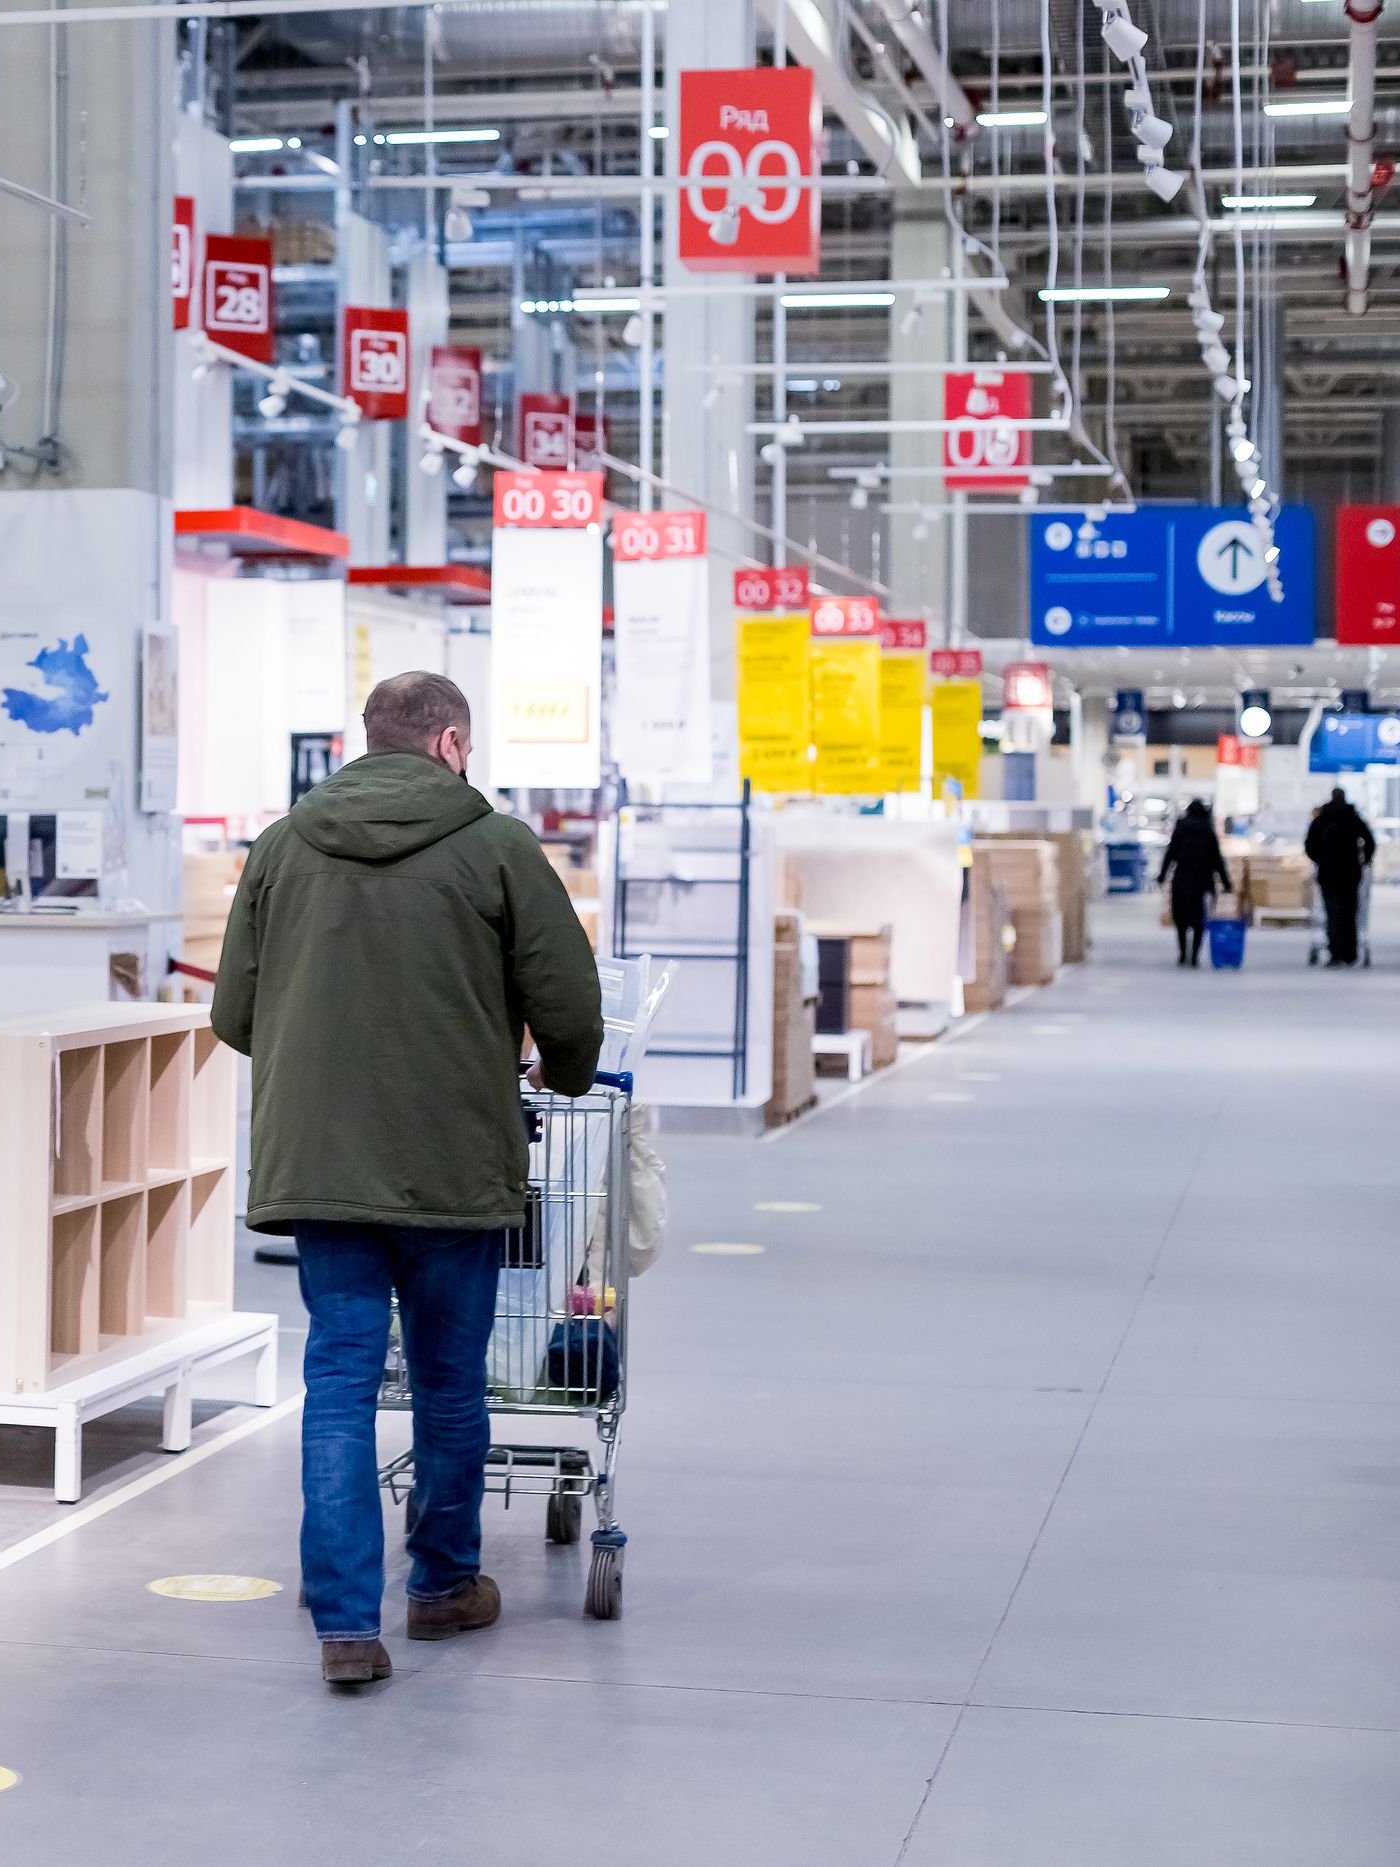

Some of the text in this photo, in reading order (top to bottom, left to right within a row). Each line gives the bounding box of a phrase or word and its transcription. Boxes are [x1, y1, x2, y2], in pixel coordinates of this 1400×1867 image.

[720, 105, 769, 133] Ряд
[216, 285, 261, 323] 28
[360, 351, 401, 383] 30
[503, 489, 593, 520] 00 30
[621, 526, 697, 555] 00 31
[738, 579, 770, 606] 00
